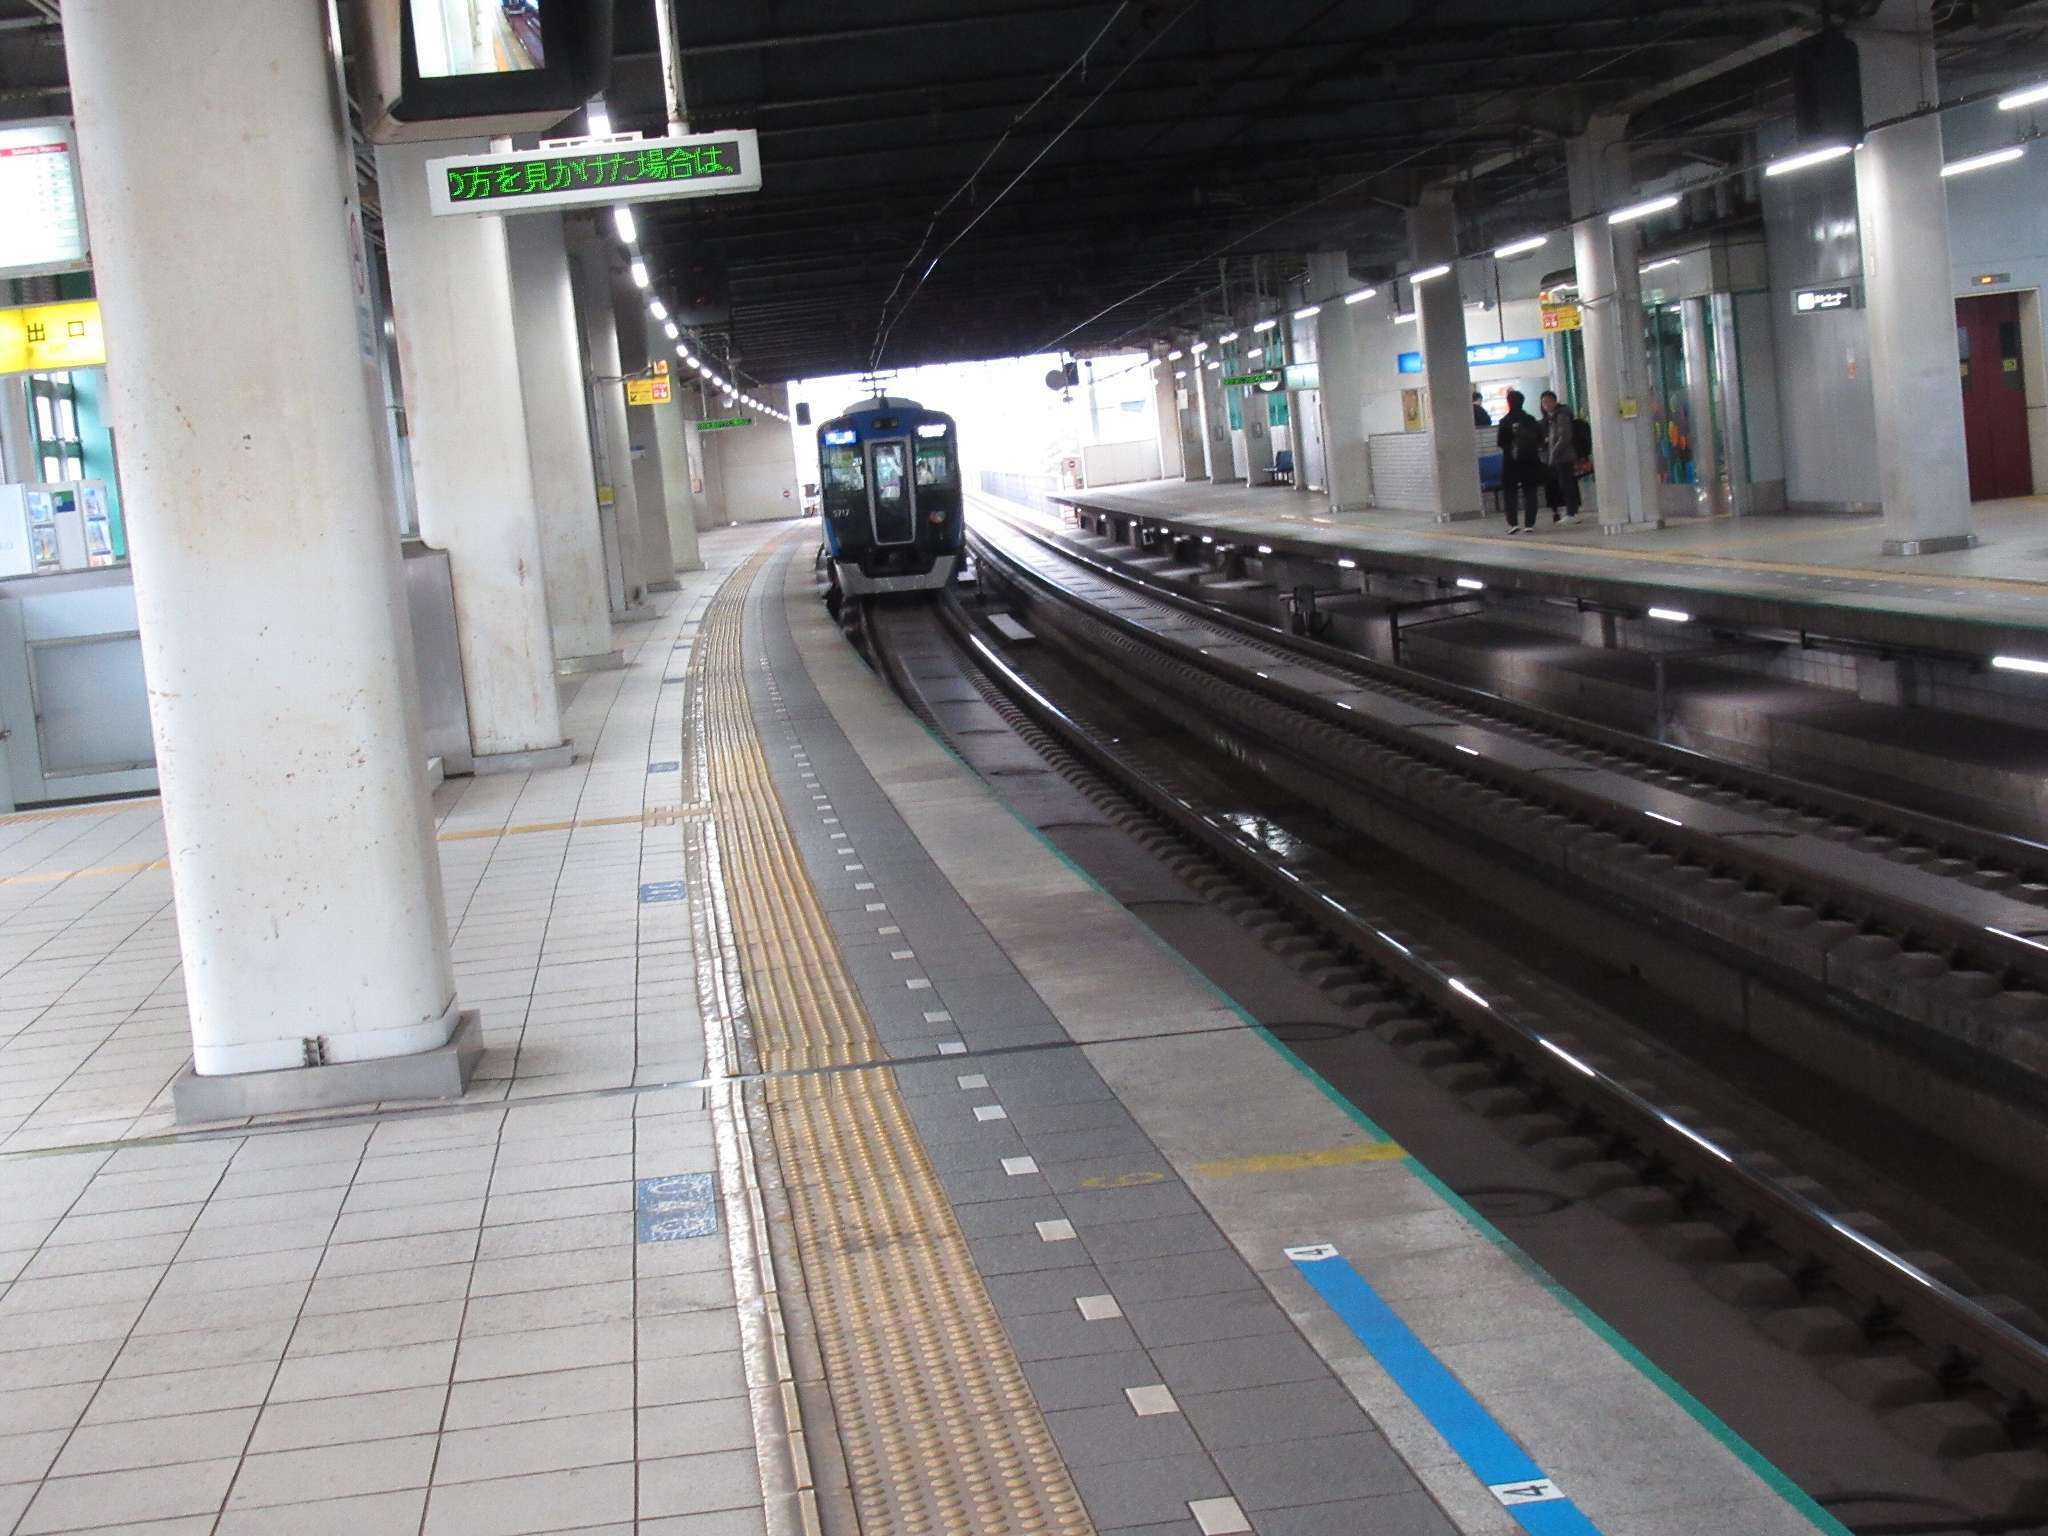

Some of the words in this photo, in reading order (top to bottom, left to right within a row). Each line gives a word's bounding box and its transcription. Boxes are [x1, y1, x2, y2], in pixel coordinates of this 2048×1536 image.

[27, 320, 85, 343] 出口
[1293, 1248, 1329, 1256] 4
[1503, 1485, 1548, 1496] 4
